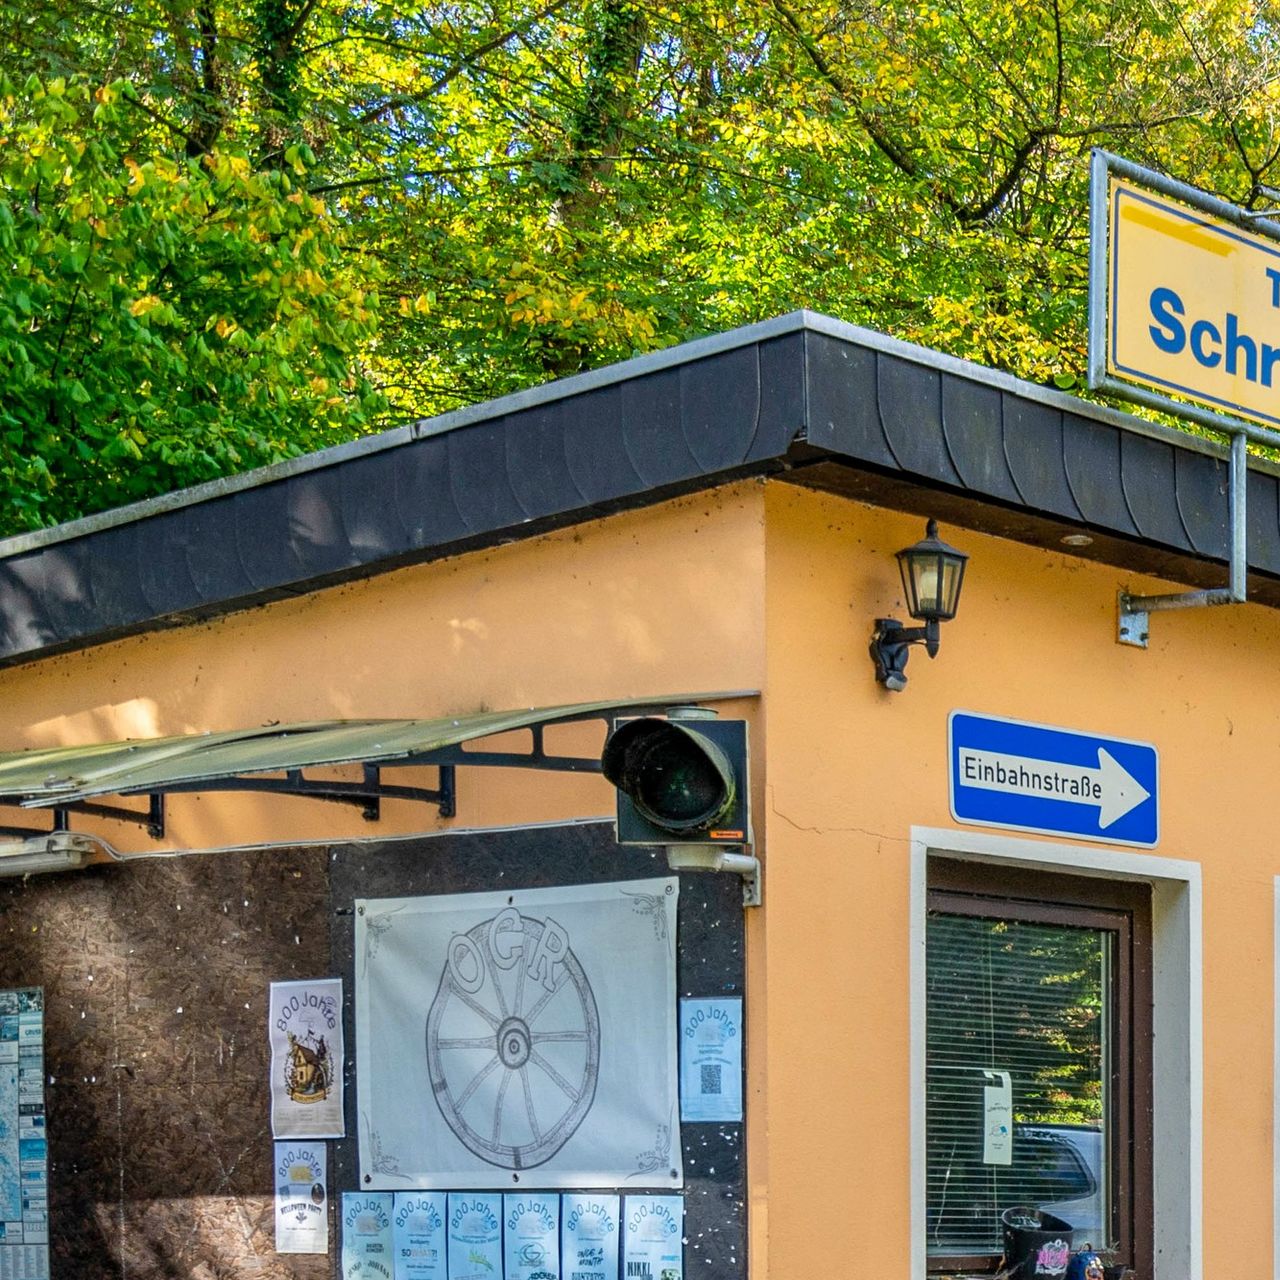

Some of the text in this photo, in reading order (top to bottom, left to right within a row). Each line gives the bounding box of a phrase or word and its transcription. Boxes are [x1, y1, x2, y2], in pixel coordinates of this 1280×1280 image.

[965, 756, 1102, 799] Einbahnstraße
[448, 907, 569, 994] OGR
[277, 991, 337, 1032] 800 Jahre
[685, 1006, 737, 1038] 800 Jahre
[279, 1148, 323, 1177] 800 Jahre
[345, 1198, 390, 1229] 800 Jahre
[395, 1198, 443, 1229] 800 Jahre
[451, 1199, 499, 1230] 800 Jahre
[507, 1200, 556, 1232] 800 Jahre
[567, 1200, 615, 1233] 800 Jahre
[629, 1201, 678, 1235] 800 Jahre
